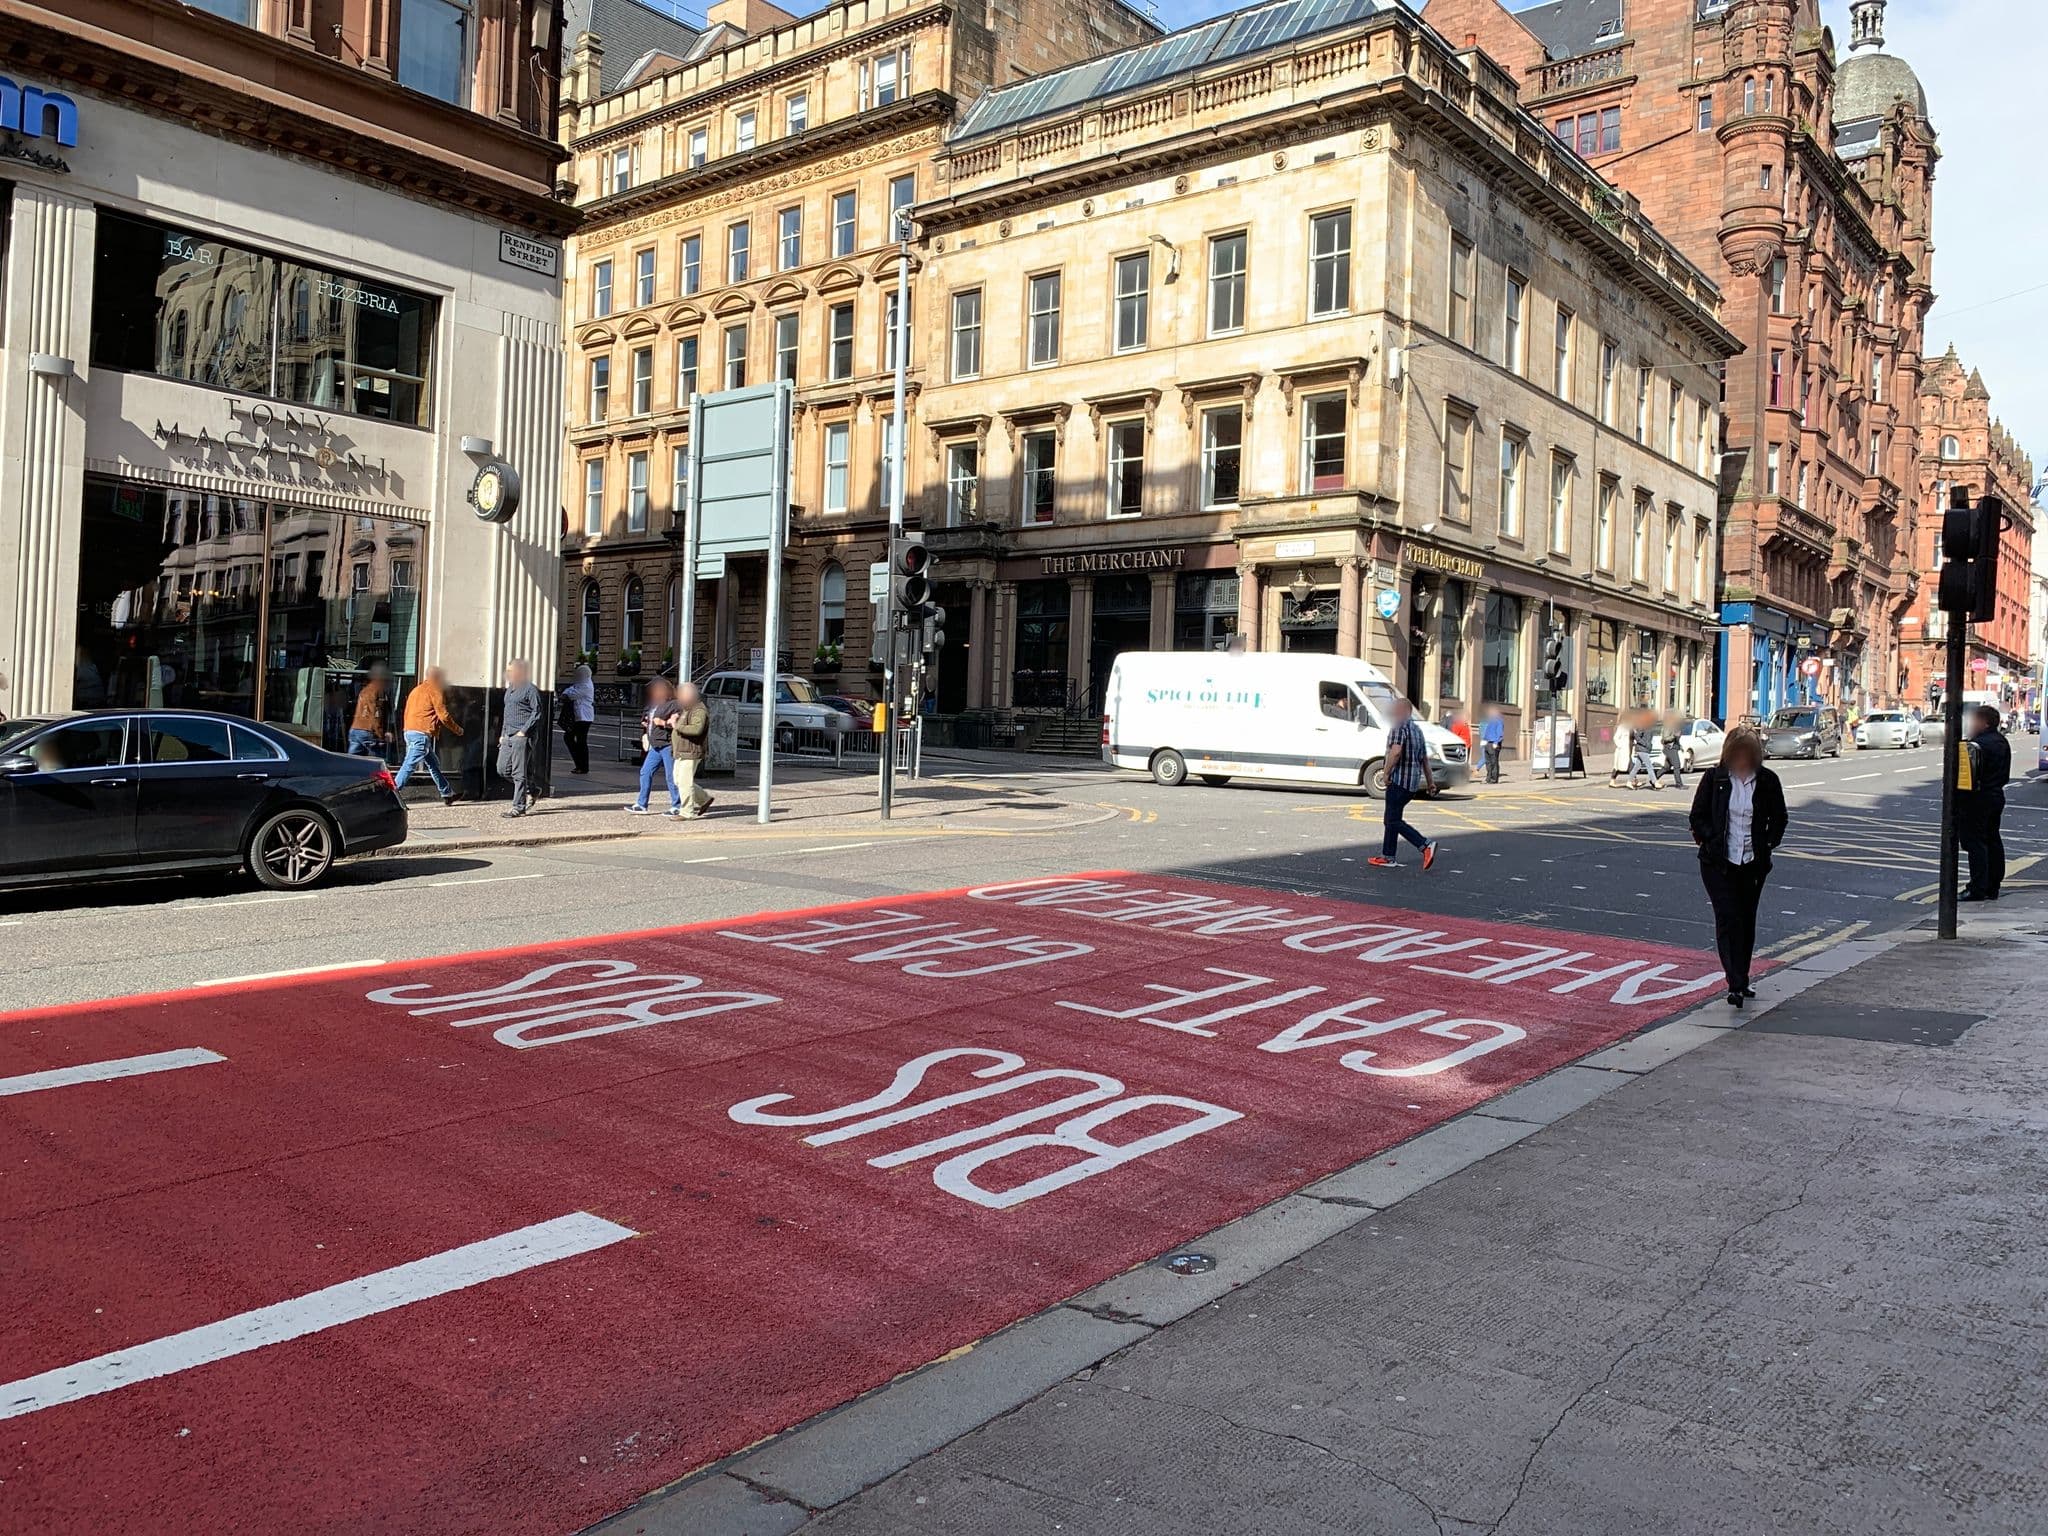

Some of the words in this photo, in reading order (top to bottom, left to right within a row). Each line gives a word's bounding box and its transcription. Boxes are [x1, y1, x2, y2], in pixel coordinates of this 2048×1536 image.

[167, 240, 214, 265] BAR
[503, 234, 554, 259] RENFIELD
[509, 246, 548, 267] STREET
[316, 279, 400, 314] PIZZERIA
[223, 397, 331, 437] TONY
[1040, 556, 1076, 574] THE
[1080, 548, 1185, 572] MERCHANT
[1406, 543, 1429, 565] THE
[1429, 548, 1485, 579] MERCHANT
[965, 878, 1335, 936] AHEAD
[716, 909, 1096, 978] GATE
[1281, 924, 1728, 1005] AHEAD
[365, 960, 783, 1049] BUS
[1055, 967, 1527, 1077] GATE
[728, 1047, 1246, 1209] BUS
